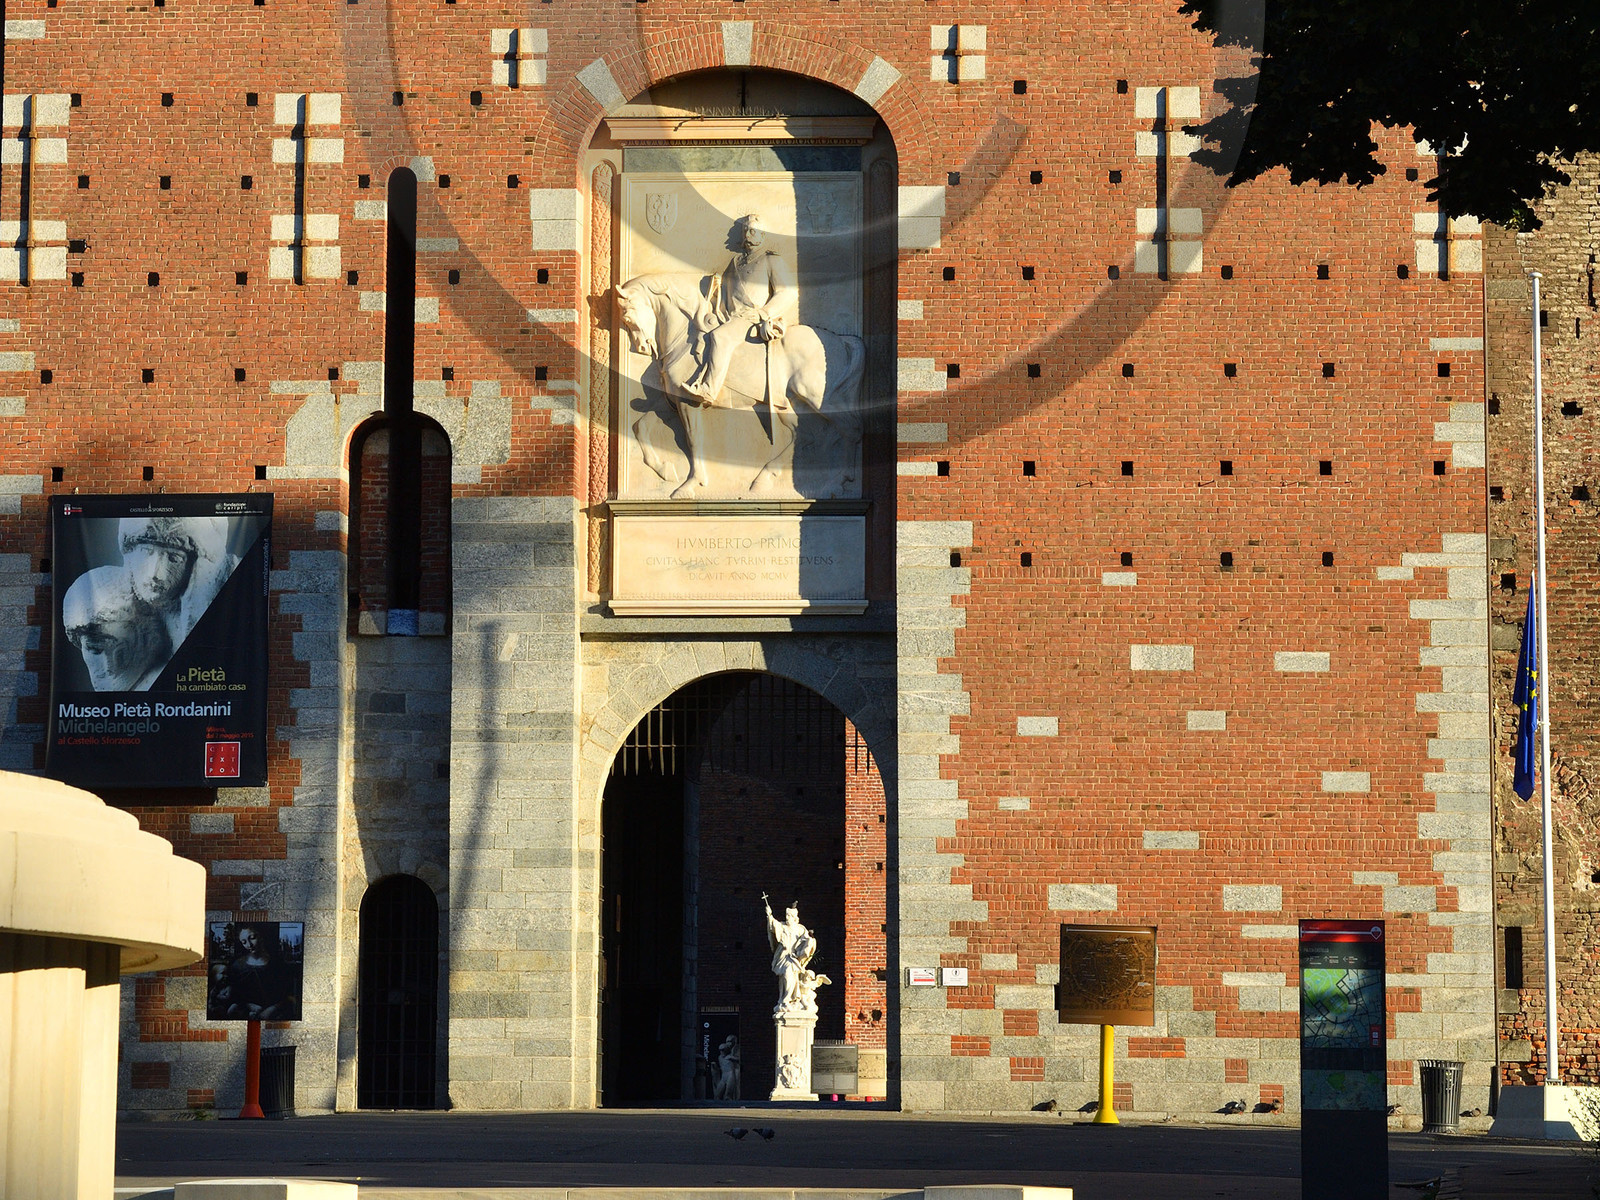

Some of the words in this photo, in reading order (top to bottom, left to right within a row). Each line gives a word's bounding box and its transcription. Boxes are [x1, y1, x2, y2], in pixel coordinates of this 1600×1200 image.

[760, 537, 802, 549] PRIMO
[176, 673, 186, 682] La
[188, 666, 226, 682] Pietà
[176, 682, 187, 692] ha
[188, 682, 227, 691] cambiato
[228, 683, 247, 691] casa
[58, 703, 111, 718] Museo
[114, 702, 151, 718] Pietà
[154, 701, 232, 717] Rondanini
[58, 718, 160, 737] Michelangelo
[58, 737, 66, 745] al
[67, 737, 100, 745] Castello
[101, 736, 141, 745] Sforzesco
